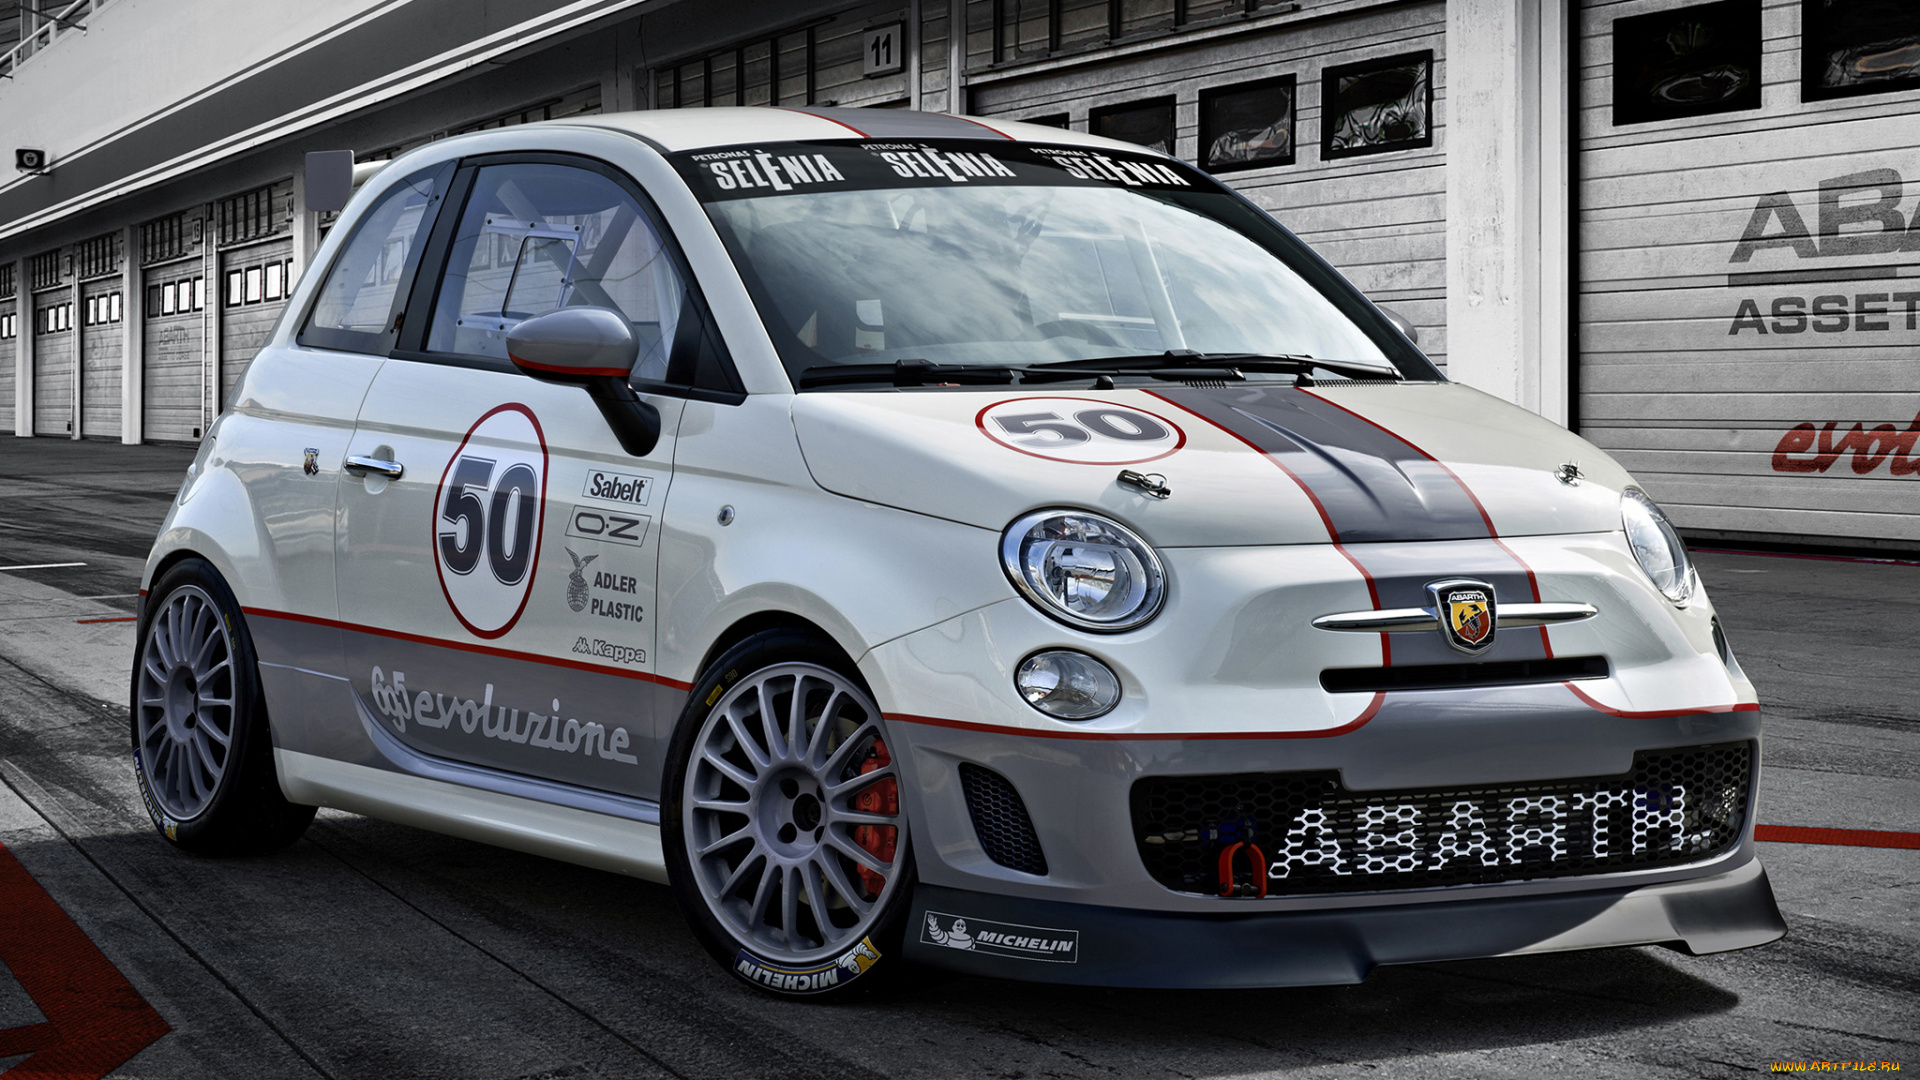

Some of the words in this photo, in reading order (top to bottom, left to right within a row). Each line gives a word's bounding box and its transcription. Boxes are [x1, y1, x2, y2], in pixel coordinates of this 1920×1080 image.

[871, 33, 892, 67] 11
[692, 150, 751, 162] PETRONAS
[861, 143, 917, 151] PETRONAS
[1728, 168, 1920, 264] AB
[990, 408, 1170, 449] 50
[590, 472, 646, 503] Sabelt
[438, 454, 538, 587] 50
[593, 571, 637, 594] ADLER
[1451, 593, 1484, 601] ABARTH
[591, 598, 643, 623] PLASTIC
[592, 639, 646, 664] Kappa
[414, 683, 639, 765] evoluzione
[134, 756, 162, 826] MICHELIN
[1268, 785, 1686, 879] ABARTH
[977, 930, 1074, 952] MICHELIN
[737, 959, 839, 991] MICHELIN
